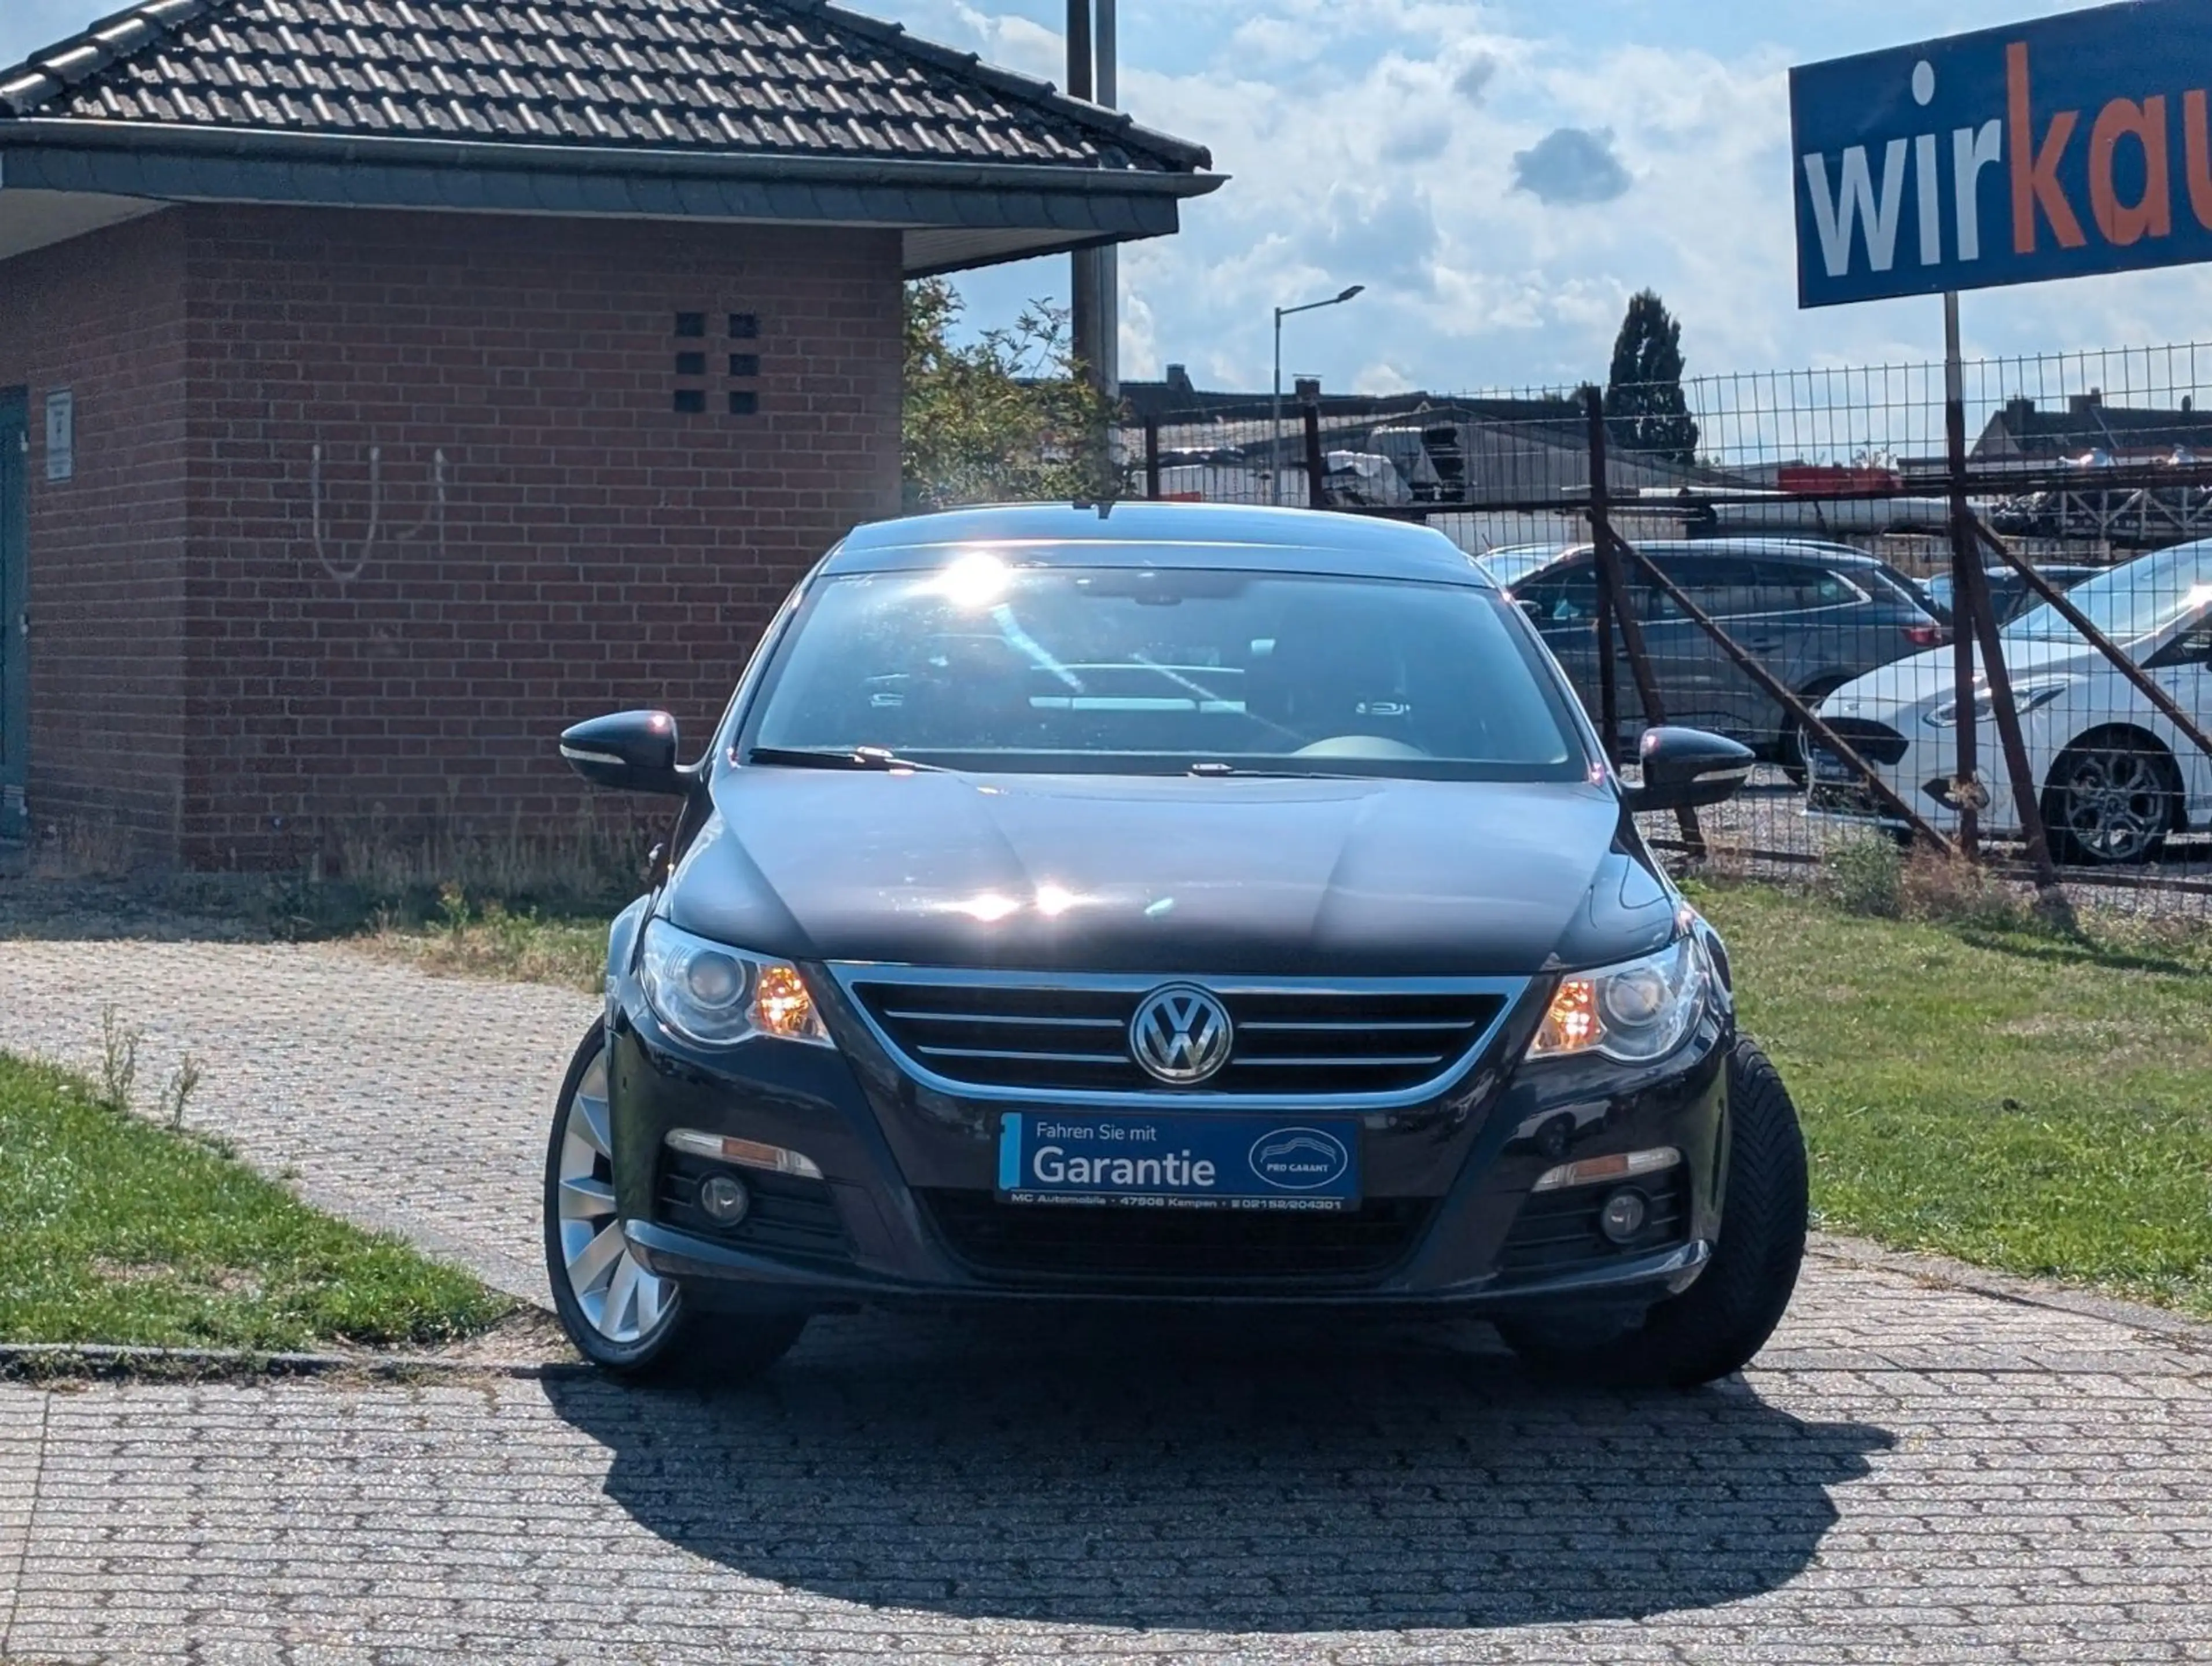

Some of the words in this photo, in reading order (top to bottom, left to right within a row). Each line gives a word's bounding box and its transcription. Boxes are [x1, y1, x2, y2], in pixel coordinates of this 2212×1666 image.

[1036, 1122, 1094, 1139] Fahren
[1099, 1123, 1125, 1140] Sie
[1129, 1125, 1157, 1141] mit
[1033, 1145, 1216, 1186] Garantie
[1011, 1193, 1034, 1203] MC
